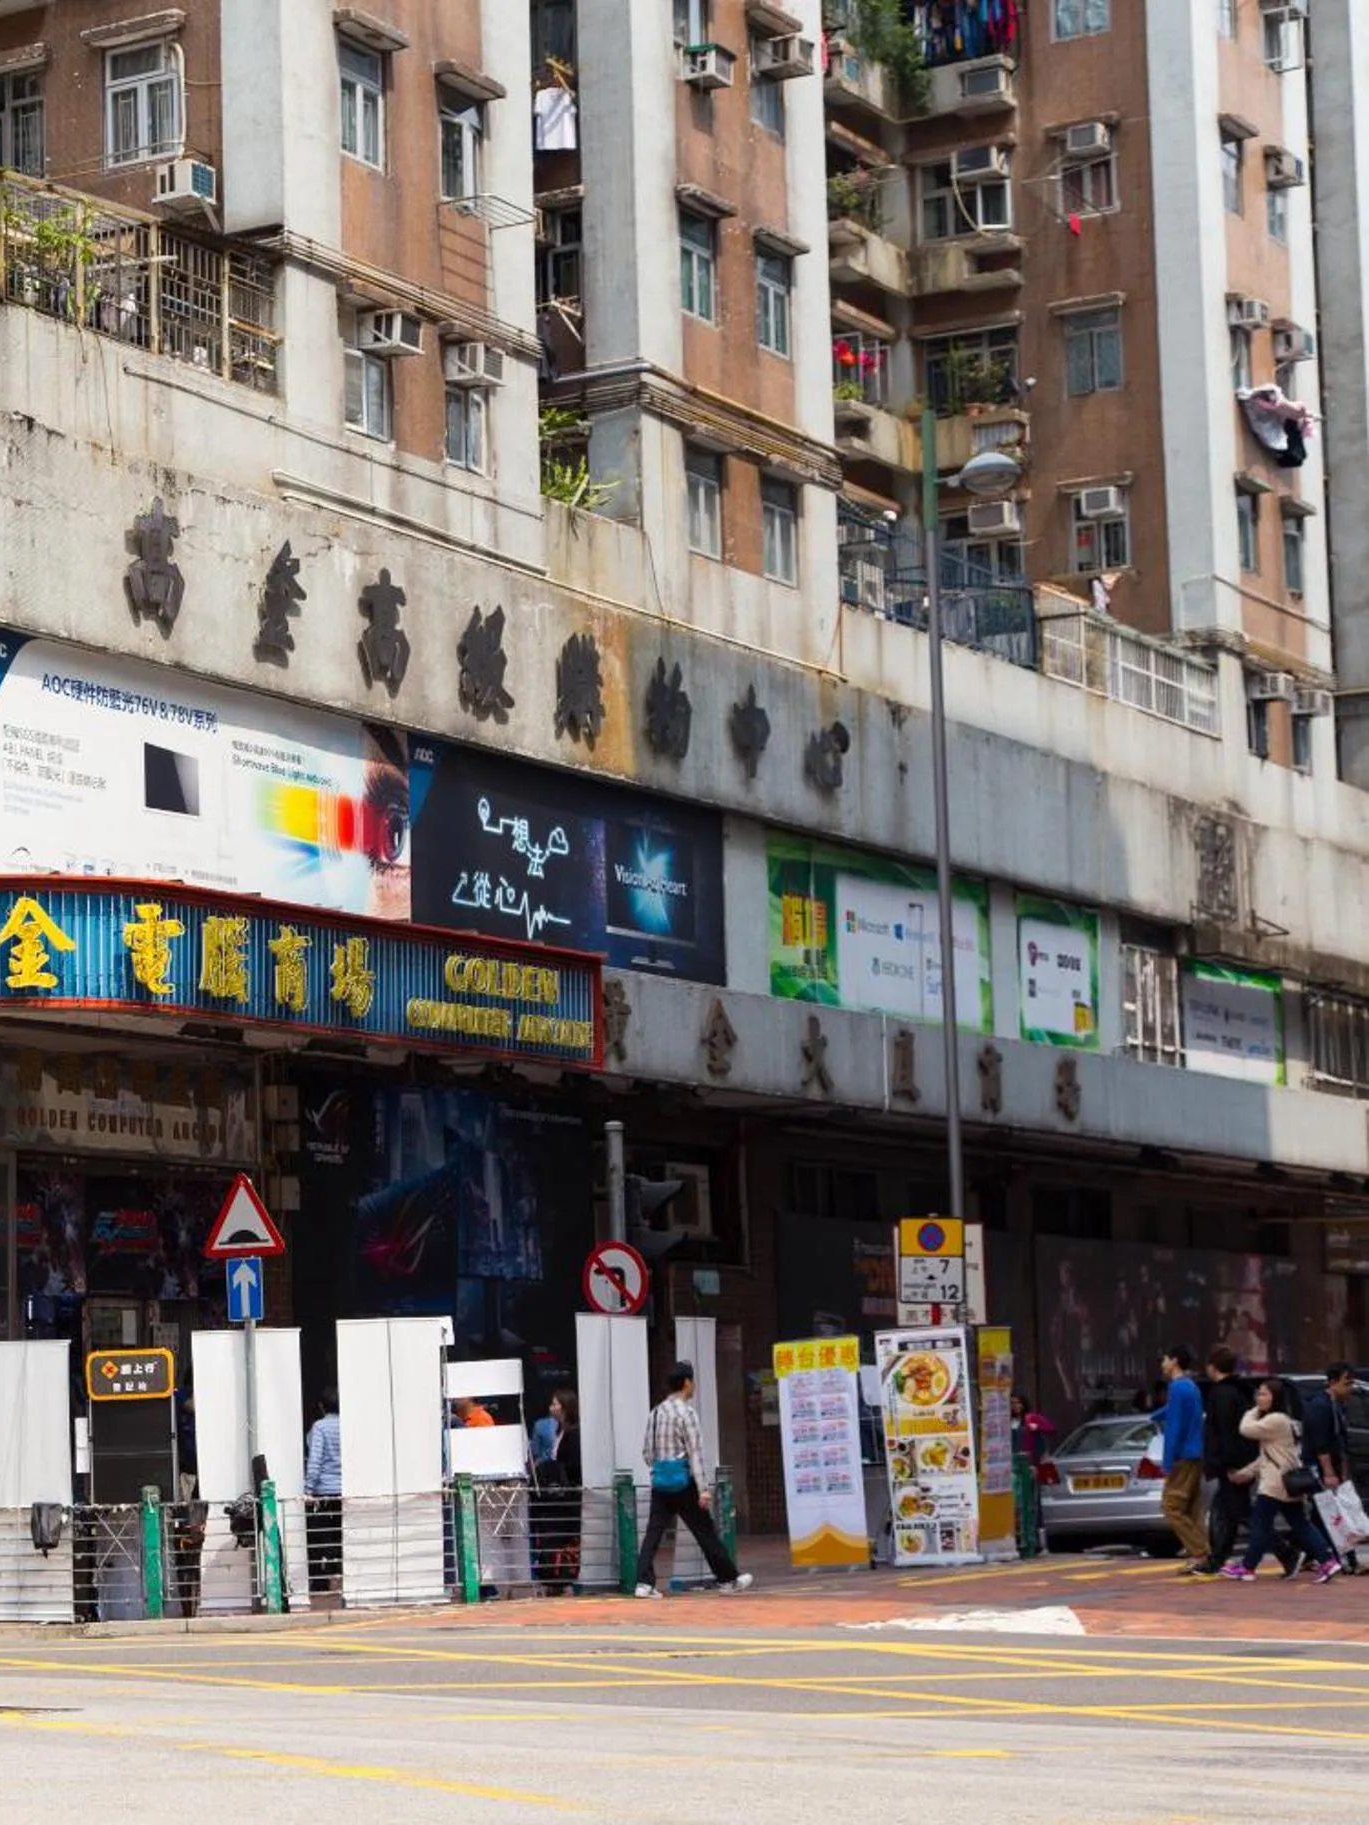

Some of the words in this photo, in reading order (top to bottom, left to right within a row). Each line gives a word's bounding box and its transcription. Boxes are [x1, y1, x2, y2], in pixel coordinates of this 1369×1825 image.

[444, 953, 560, 1004] GOLDEN
[407, 997, 512, 1039] COMPUTER
[517, 1013, 594, 1048] ARCADE
[18, 1106, 78, 1131] GOLDEN
[88, 1111, 164, 1140] COMPUTER
[939, 1258, 950, 1275] 7
[940, 1283, 960, 1300] 12
